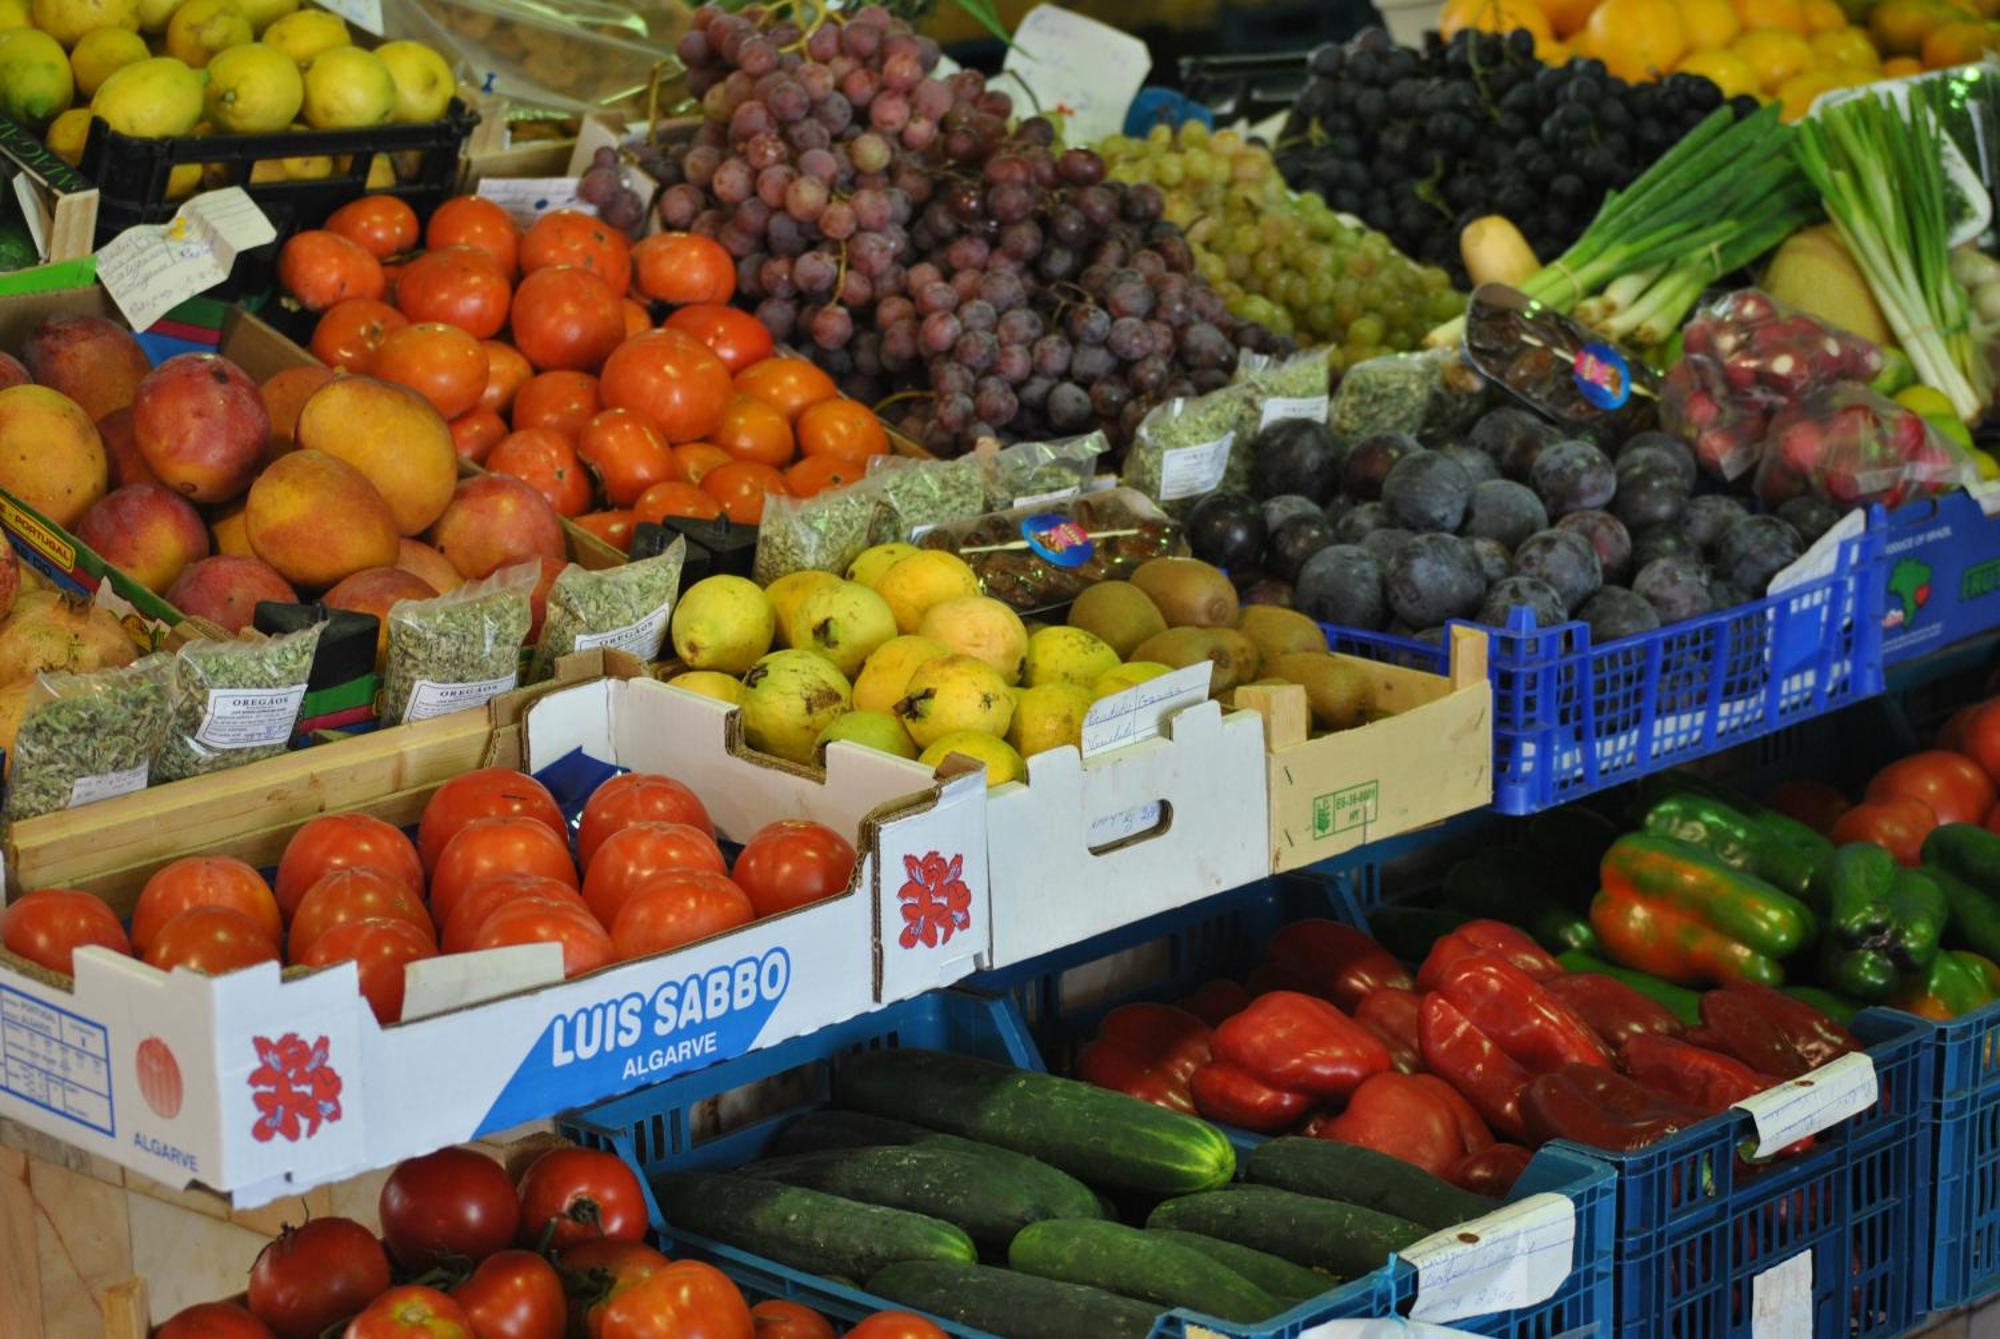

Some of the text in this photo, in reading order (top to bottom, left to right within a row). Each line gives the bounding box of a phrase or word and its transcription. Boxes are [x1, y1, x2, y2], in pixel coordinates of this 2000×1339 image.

[15, 513, 68, 560] PORTUGAL
[552, 949, 789, 1068] LUIS SABBO
[620, 1031, 718, 1080] ALGARVE
[134, 1131, 199, 1173] ALGARVE
